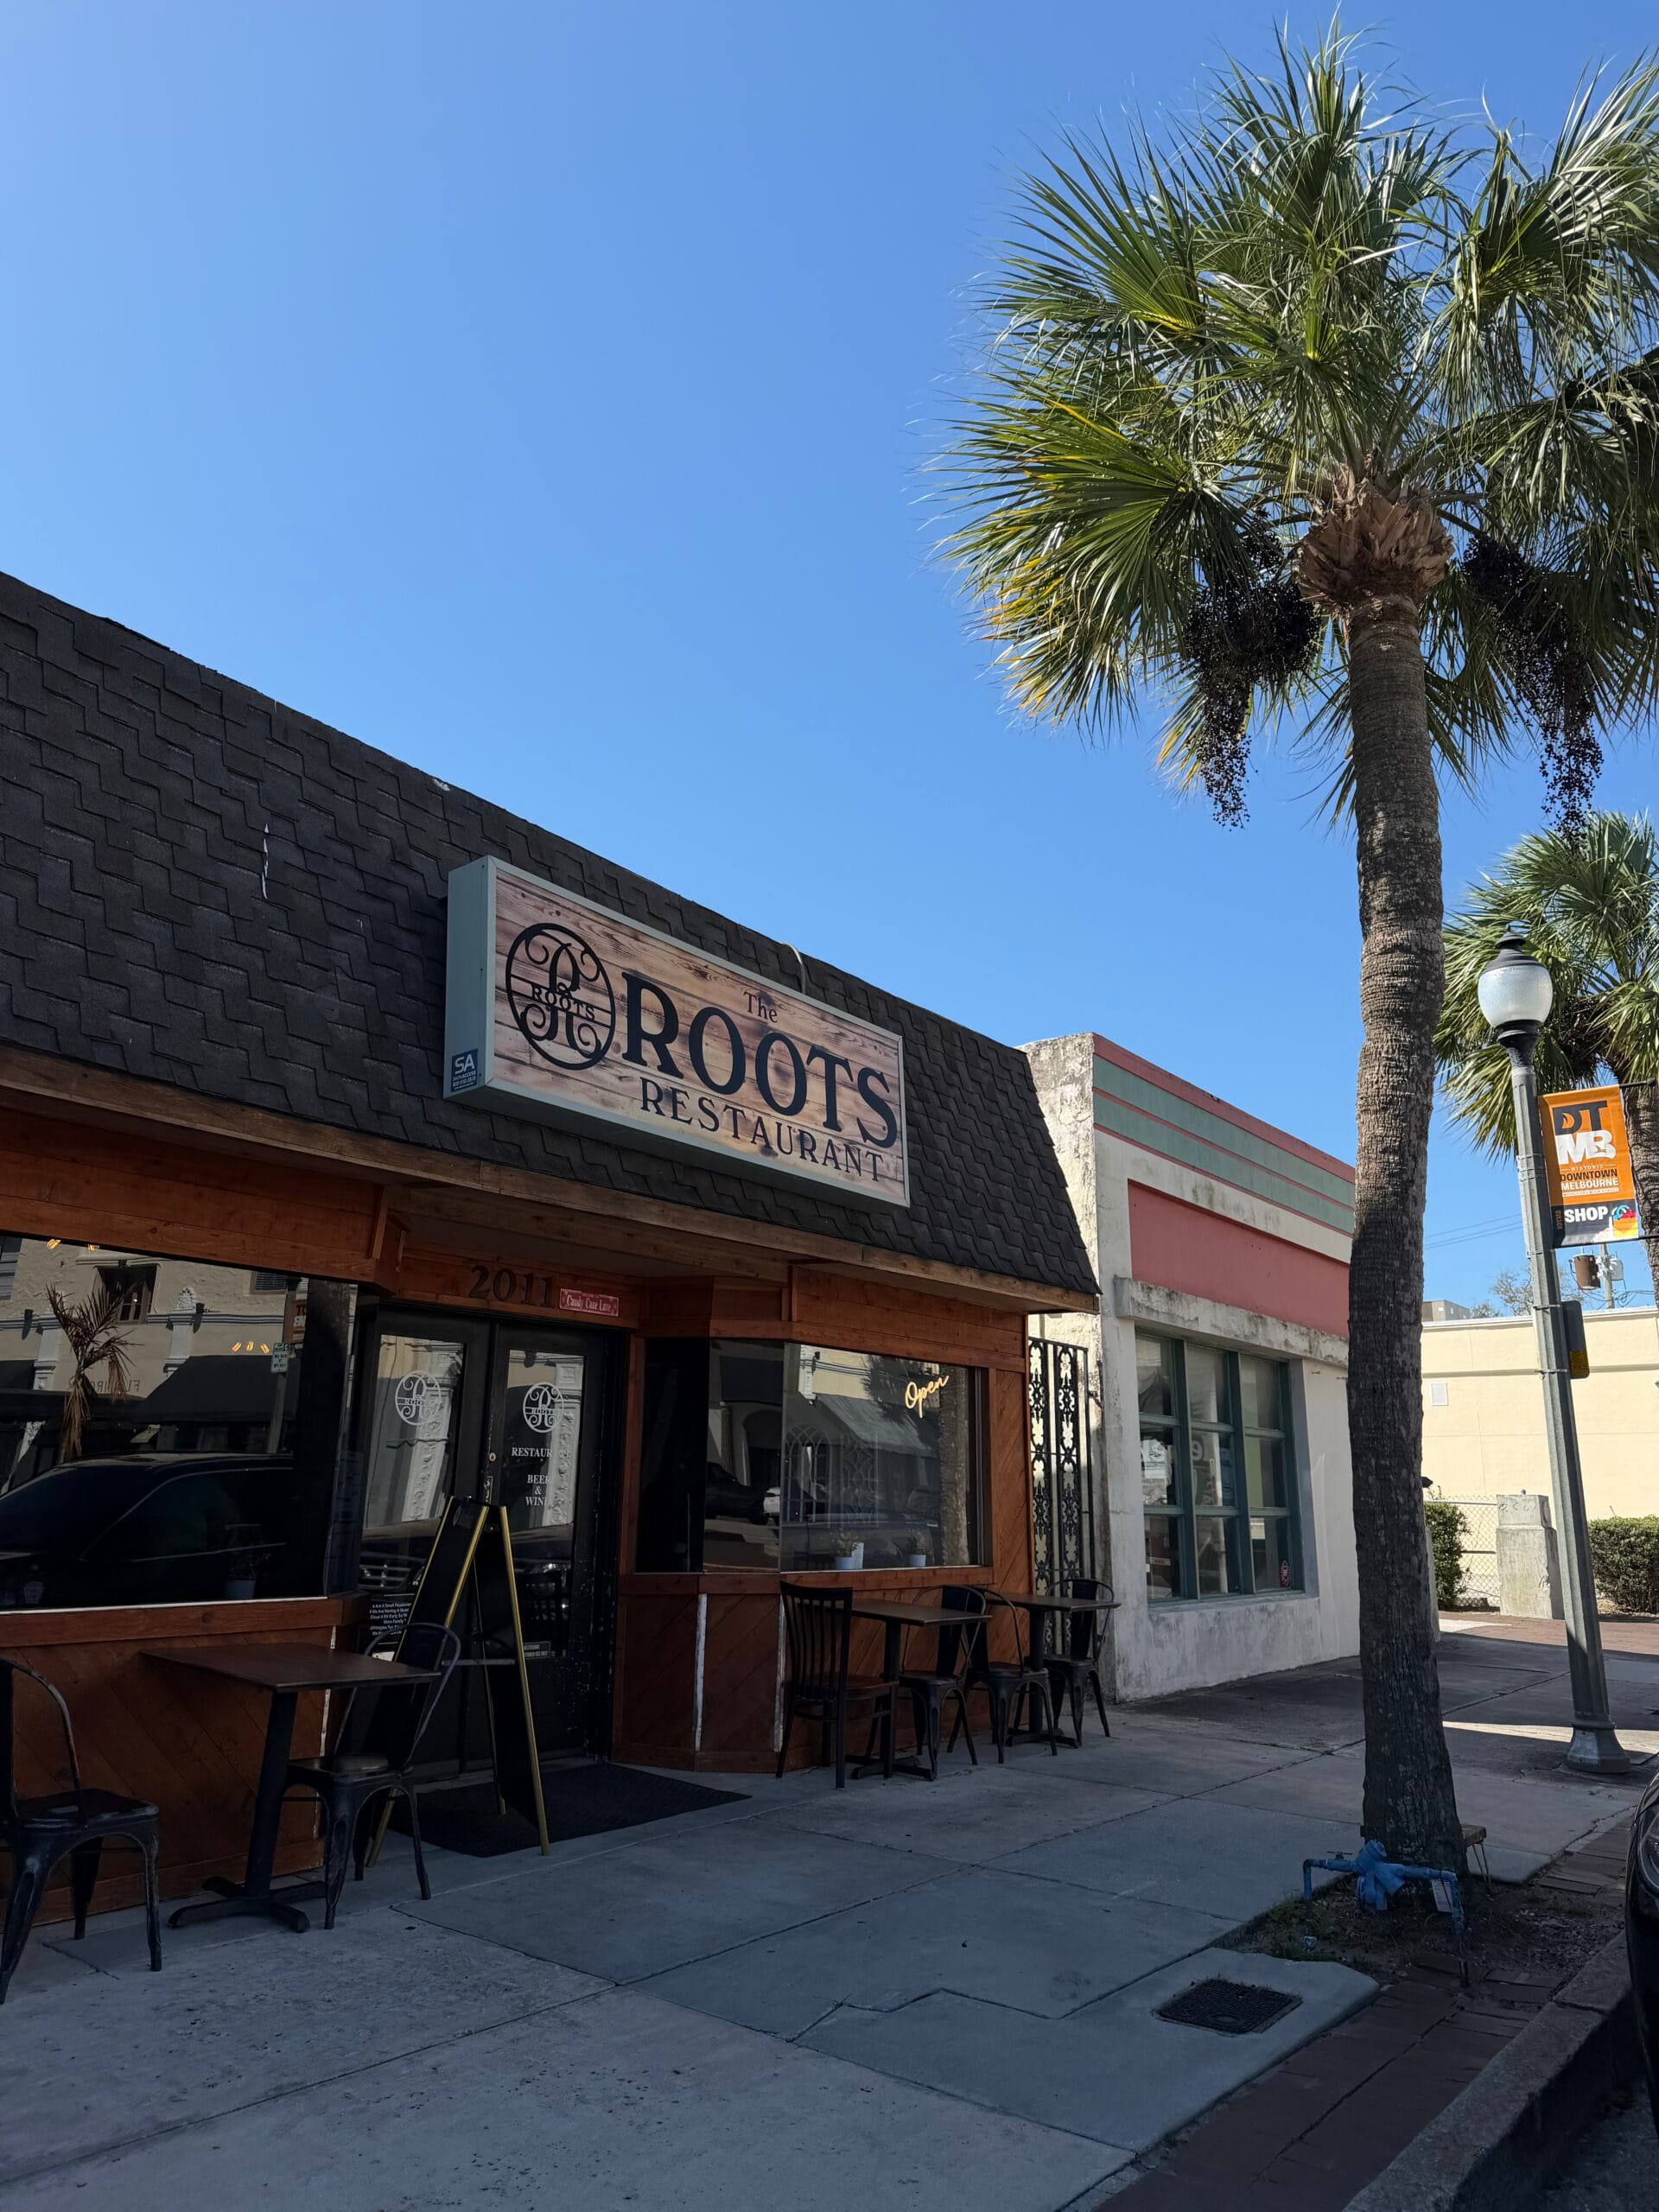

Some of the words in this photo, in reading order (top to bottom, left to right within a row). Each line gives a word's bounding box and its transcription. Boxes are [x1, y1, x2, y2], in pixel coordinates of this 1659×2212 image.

[531, 983, 595, 1020] ROOTS
[743, 990, 779, 1023] The
[454, 1053, 475, 1075] SA
[621, 972, 898, 1148] ROOTS
[640, 1078, 884, 1183] RESTAURANT
[1553, 1100, 1607, 1135] DT
[1555, 1130, 1617, 1165] MB
[1560, 1168, 1618, 1181] DOWNTOWN
[1561, 1177, 1618, 1191] MELBOURNE
[1564, 1205, 1608, 1223] SHOP
[468, 1265, 555, 1308] 2011
[567, 1294, 582, 1309] Candy
[906, 1376, 949, 1418] Open
[512, 1447, 552, 1458] RESTAUR
[527, 1474, 550, 1484] BEER
[534, 1485, 543, 1495] &
